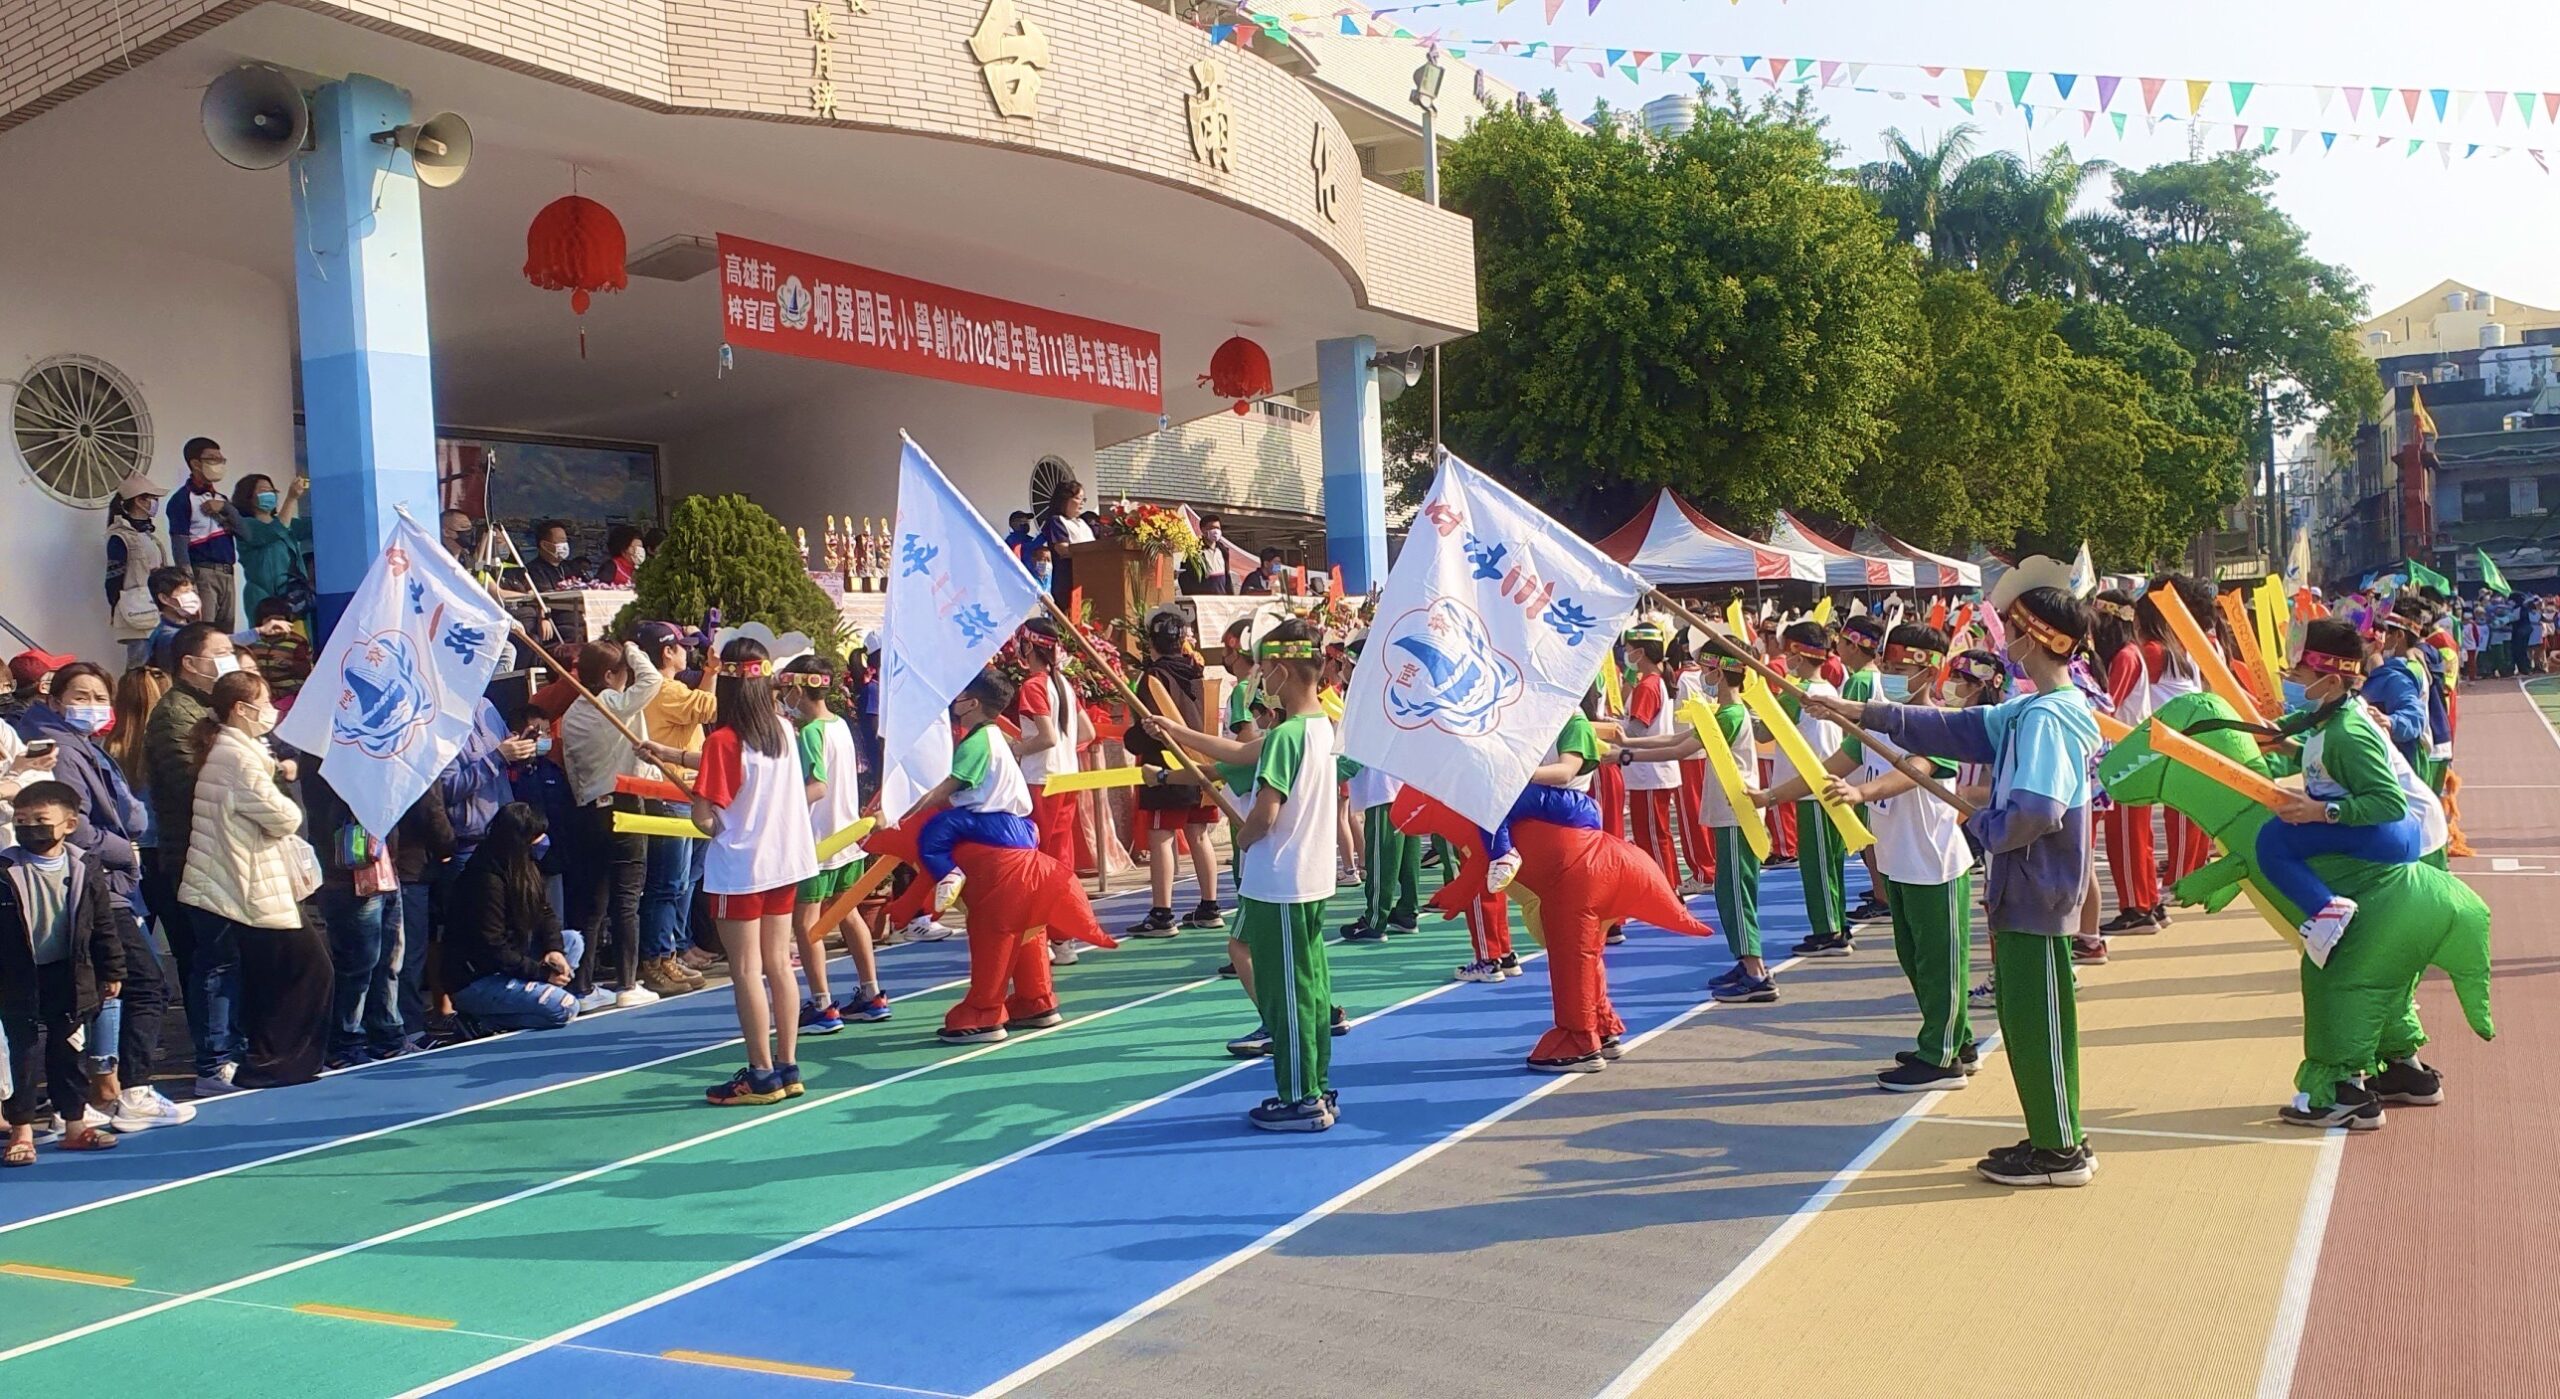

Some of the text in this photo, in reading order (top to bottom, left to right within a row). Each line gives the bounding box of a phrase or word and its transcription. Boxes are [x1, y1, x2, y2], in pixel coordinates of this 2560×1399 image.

[725, 252, 776, 292] 高雄市
[727, 294, 776, 333] 梓官區
[813, 278, 1158, 396] 蚵寮國民小學創校102週年暨111學年度運動大會
